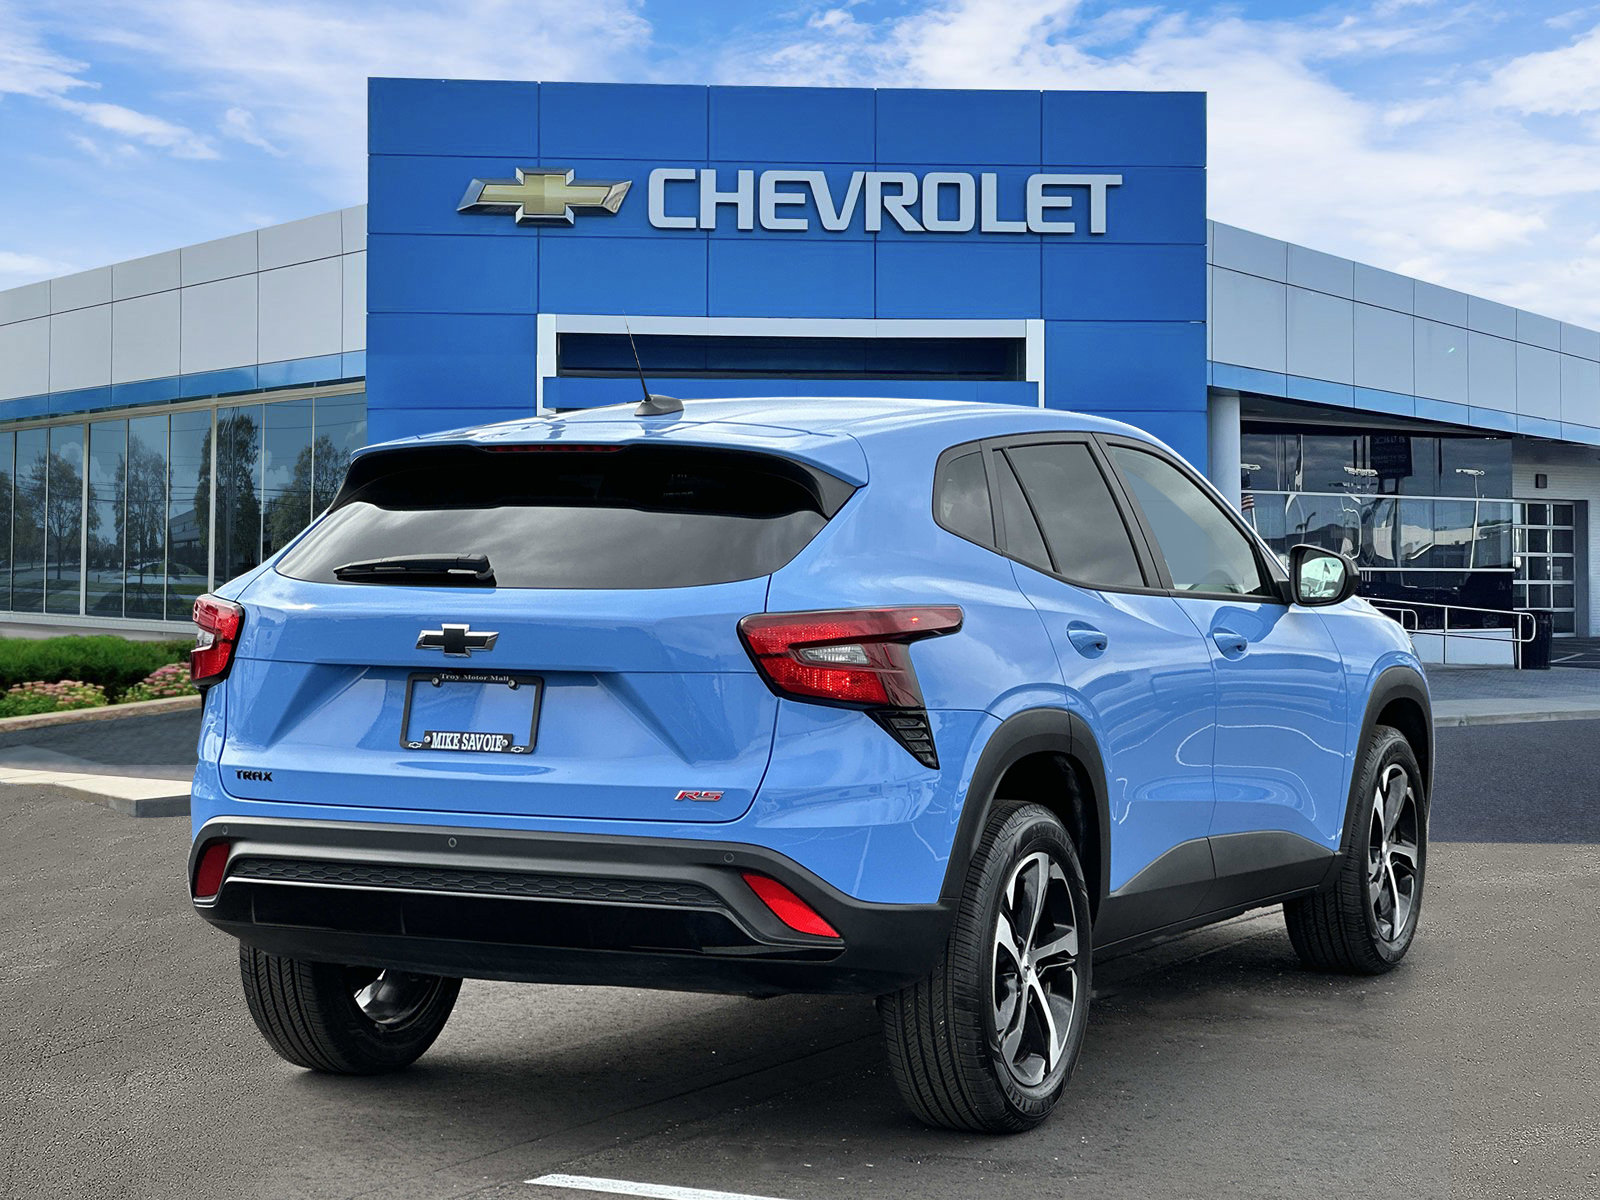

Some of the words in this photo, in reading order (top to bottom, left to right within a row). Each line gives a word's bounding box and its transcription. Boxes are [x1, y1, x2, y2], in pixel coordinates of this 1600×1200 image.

[648, 168, 1123, 234] CHEVROLET
[440, 673, 460, 681] Troy
[431, 732, 460, 749] MIKE
[461, 733, 503, 752] SAVOIE
[235, 769, 273, 782] TRAX
[674, 790, 725, 802] RS
